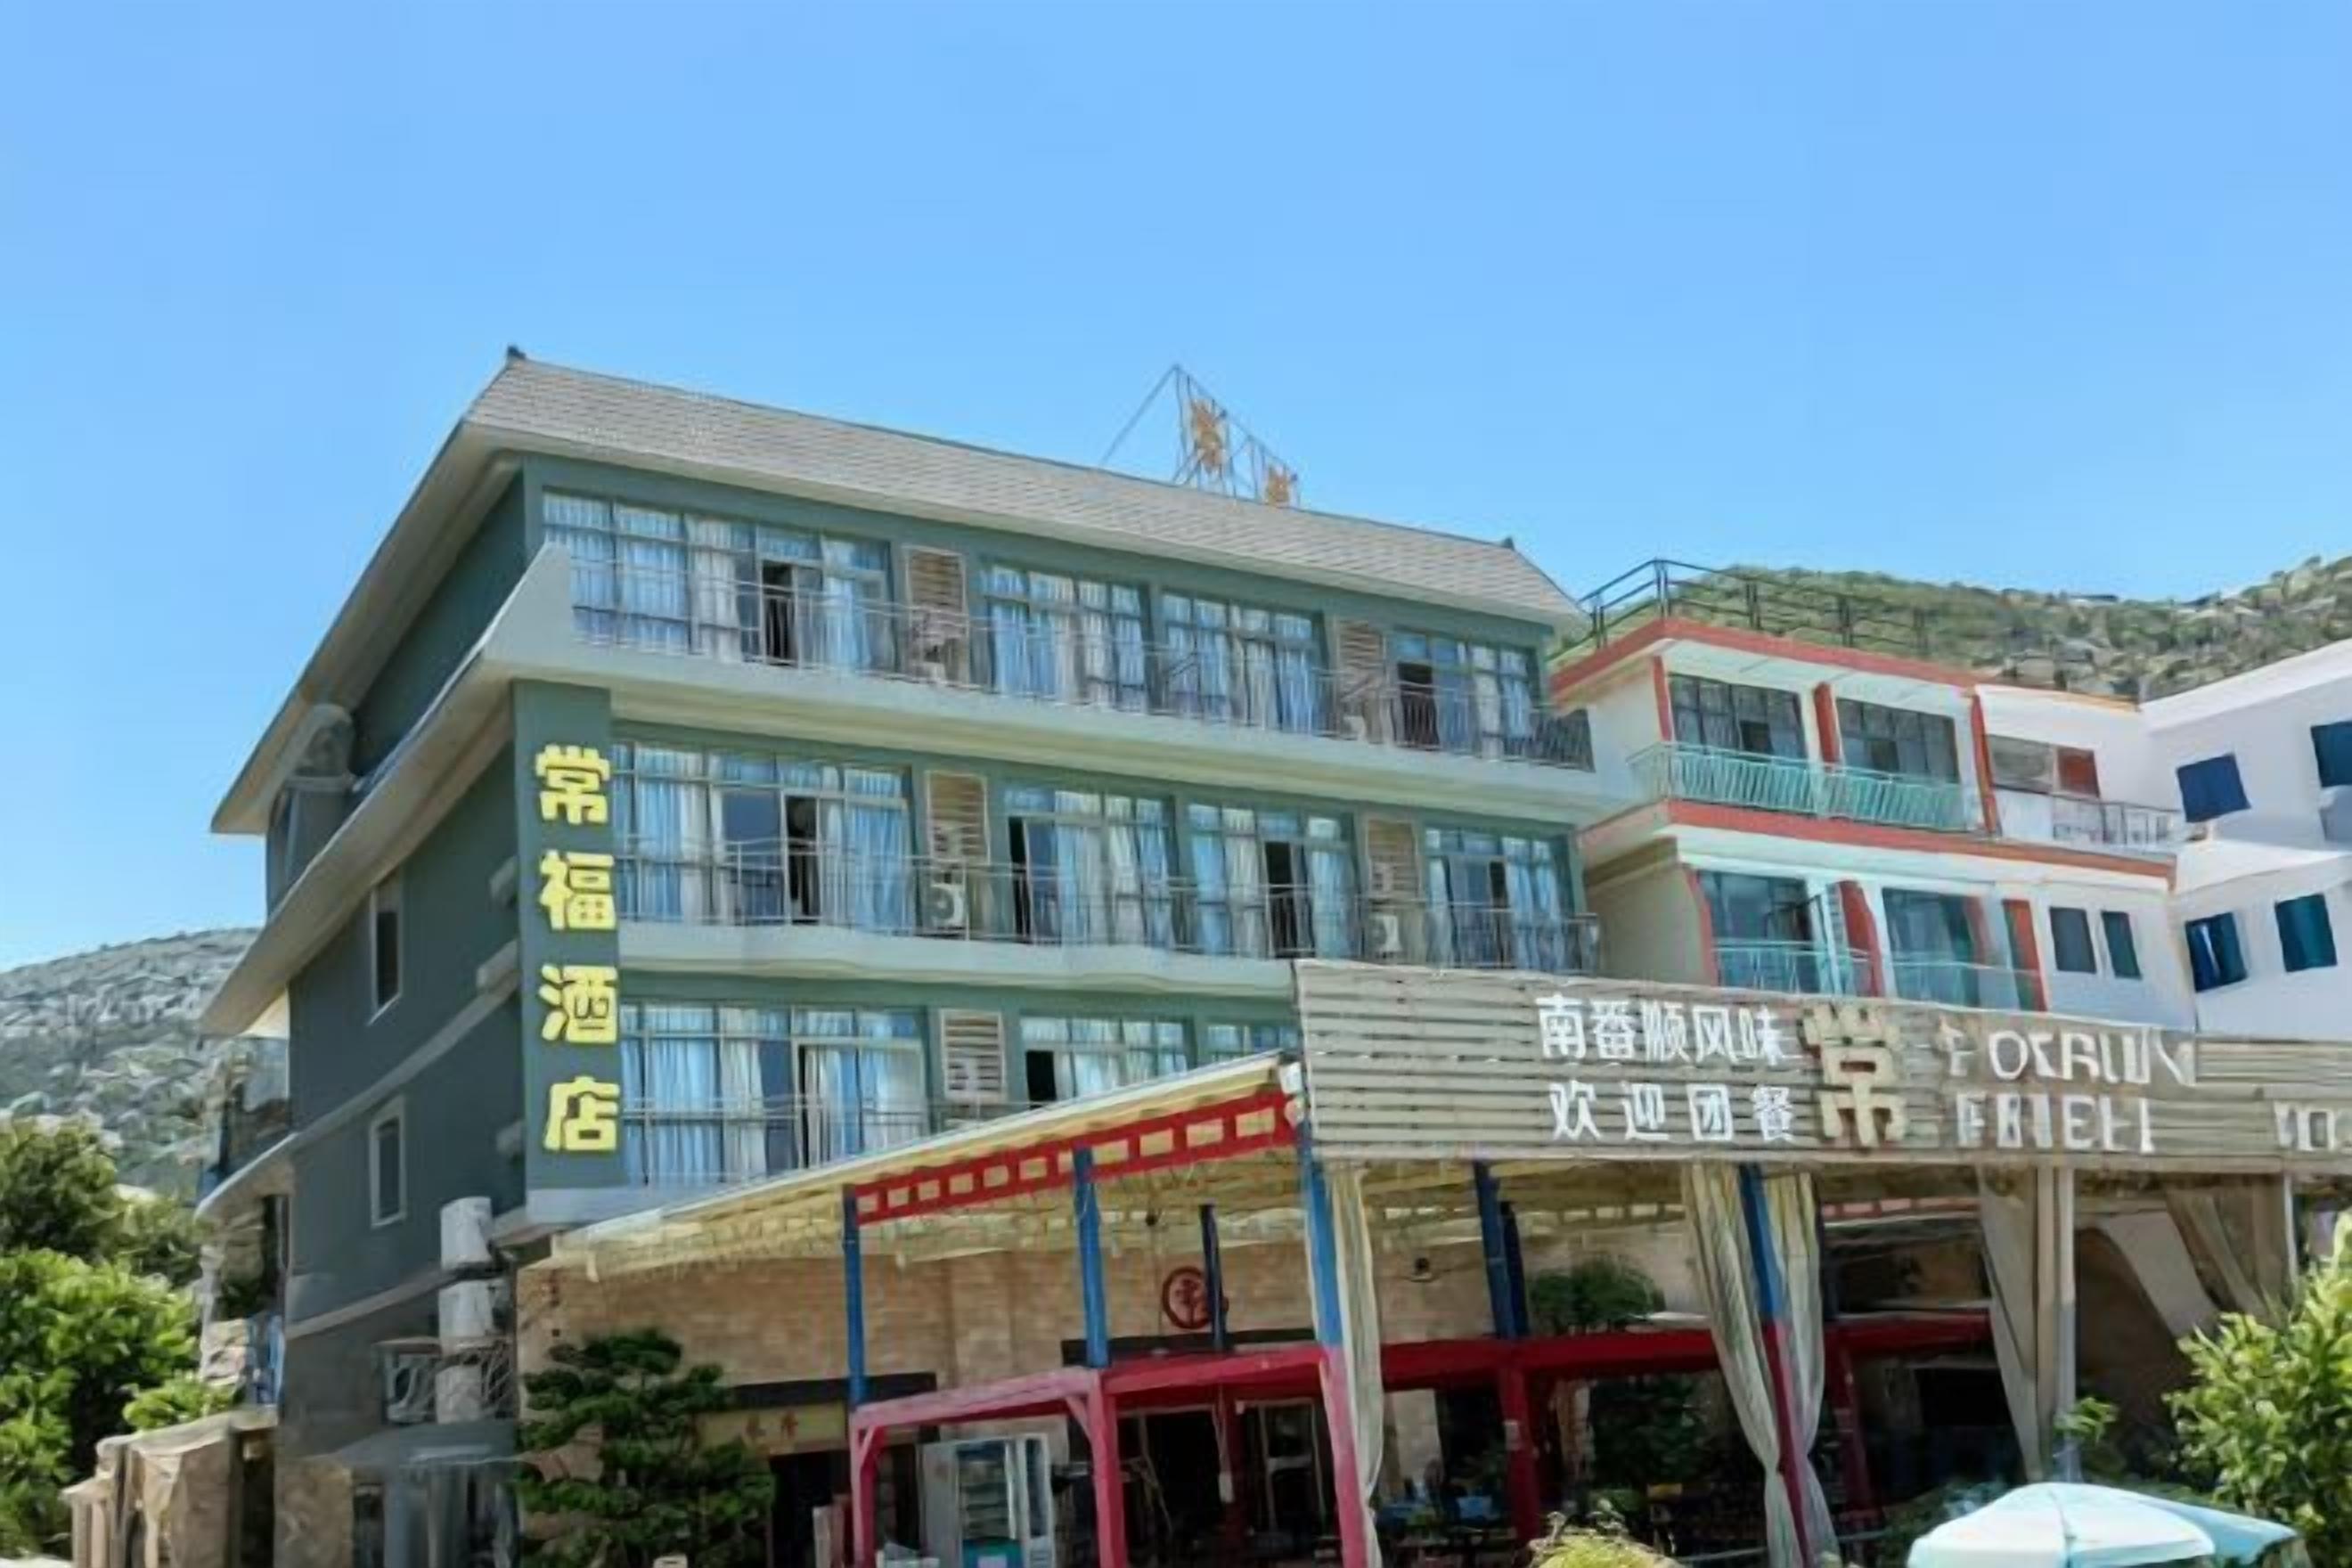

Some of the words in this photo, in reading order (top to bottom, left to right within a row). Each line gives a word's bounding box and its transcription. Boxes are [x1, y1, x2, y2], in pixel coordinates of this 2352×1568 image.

[535, 744, 621, 1152] 常福酒店
[1534, 993, 1783, 1066] 南番顺风味
[1801, 1003, 1907, 1149] 常
[1548, 1079, 1796, 1142] 欢迎团餐
